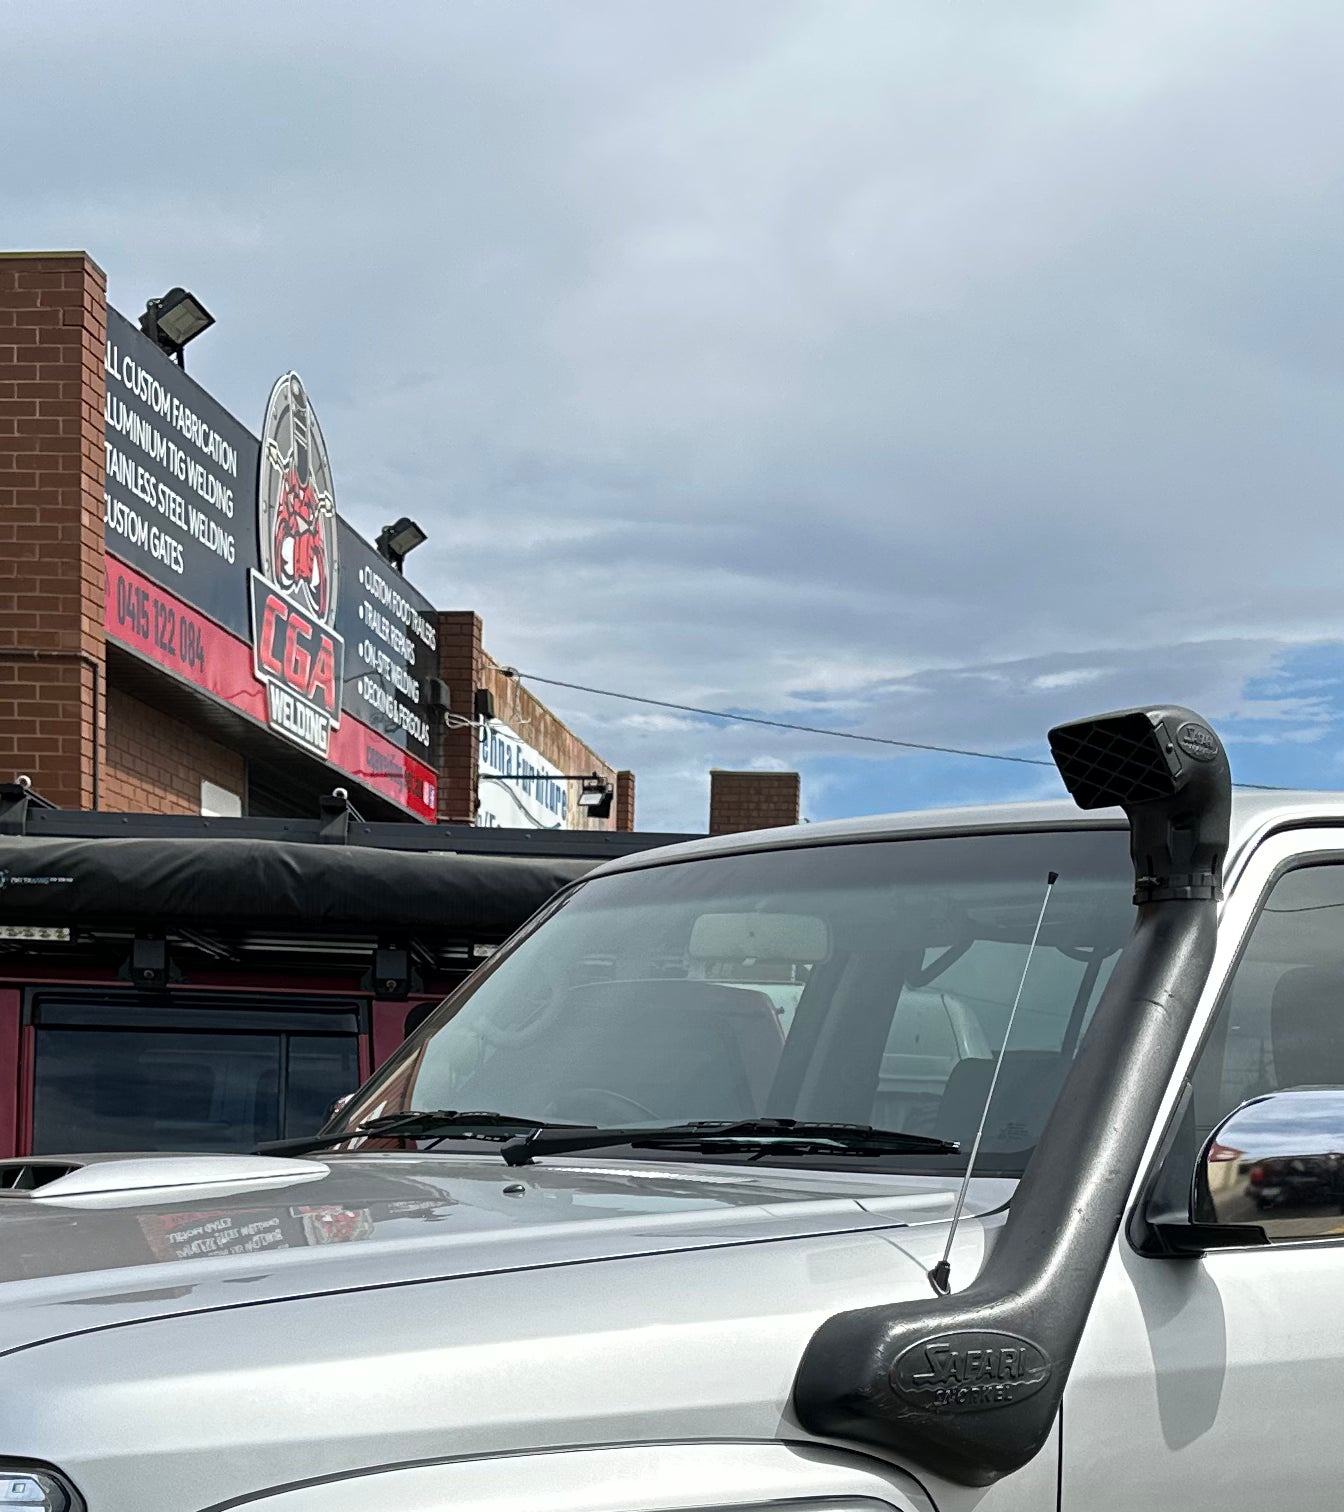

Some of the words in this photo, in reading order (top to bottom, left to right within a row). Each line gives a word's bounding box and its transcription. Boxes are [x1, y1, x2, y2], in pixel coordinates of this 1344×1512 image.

[123, 356, 171, 422] CUSTOM
[172, 398, 237, 477] FABRICATION
[168, 441, 186, 481] TIG
[186, 456, 234, 518] WELDING
[150, 526, 184, 574] GATES
[158, 483, 188, 531] STEEL
[188, 505, 235, 564] WELDING
[117, 575, 150, 640] 0415
[153, 598, 176, 656] 122
[180, 616, 205, 673] 084
[260, 594, 336, 712] CGA
[269, 683, 328, 749] WELDING
[913, 1342, 1027, 1385] SAFARI
[934, 1385, 1014, 1406] SNORKEL
